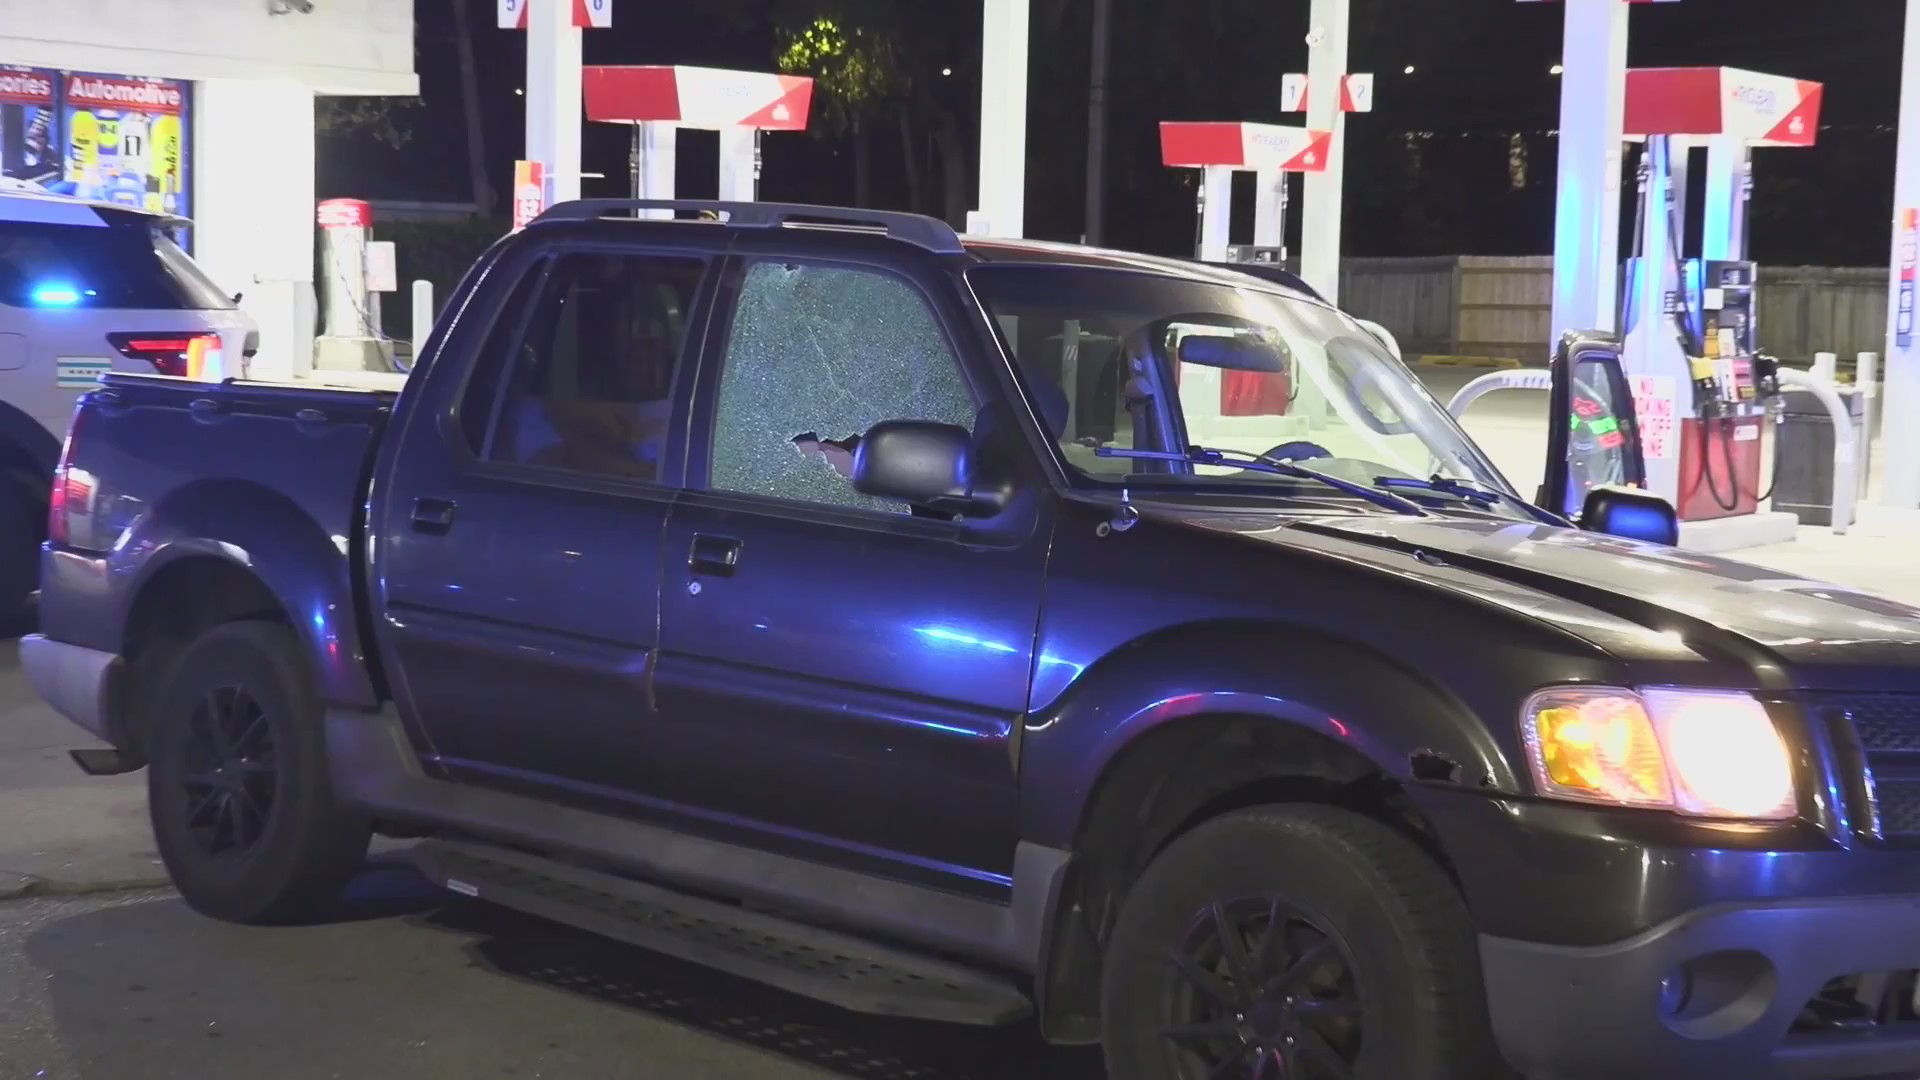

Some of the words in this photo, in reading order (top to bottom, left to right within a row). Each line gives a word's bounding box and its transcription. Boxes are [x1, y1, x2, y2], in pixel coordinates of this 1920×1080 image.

[0, 73, 51, 96] ories
[69, 77, 181, 105] Automotive
[1289, 85, 1296, 99] 1
